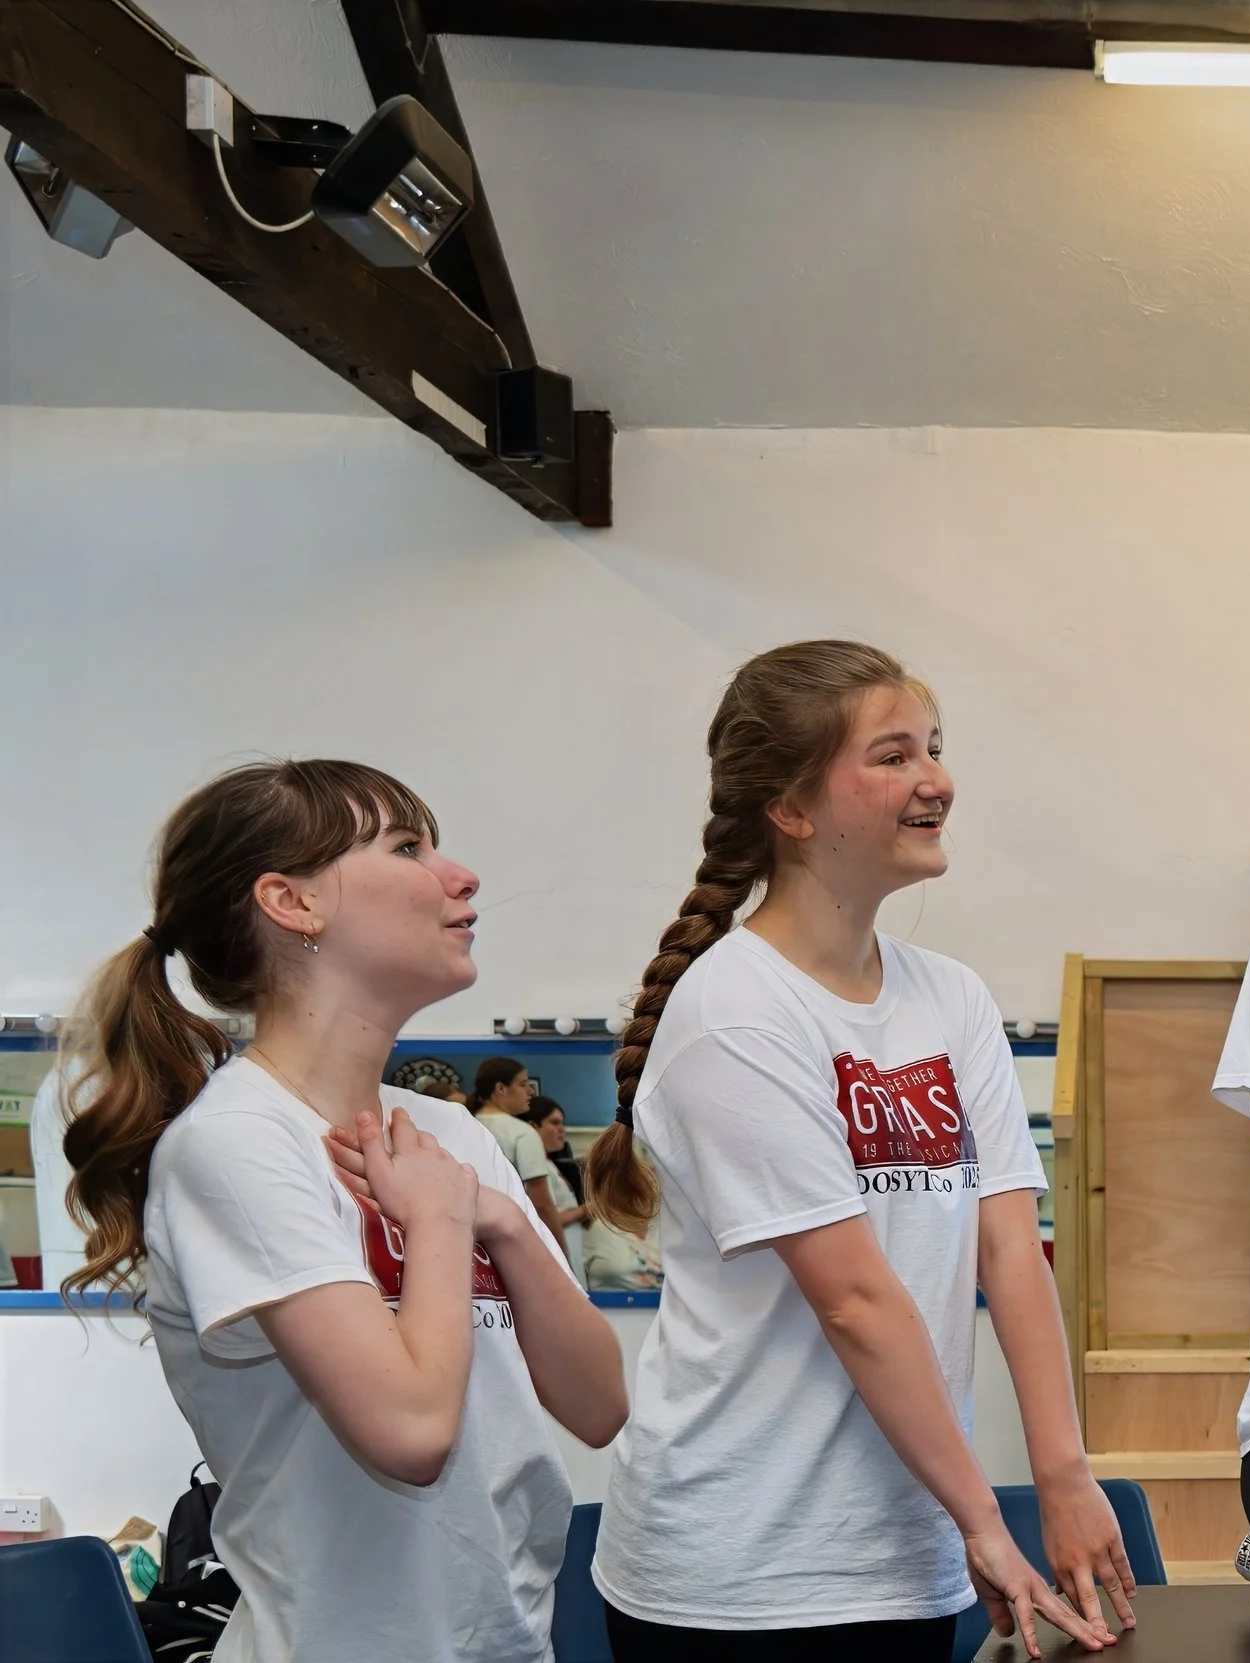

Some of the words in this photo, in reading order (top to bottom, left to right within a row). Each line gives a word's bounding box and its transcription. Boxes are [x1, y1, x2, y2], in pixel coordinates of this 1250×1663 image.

[886, 1067, 938, 1093] GETHER
[849, 1081, 973, 1142] GRAS
[862, 1143, 877, 1158] 19
[887, 1141, 912, 1157] THE
